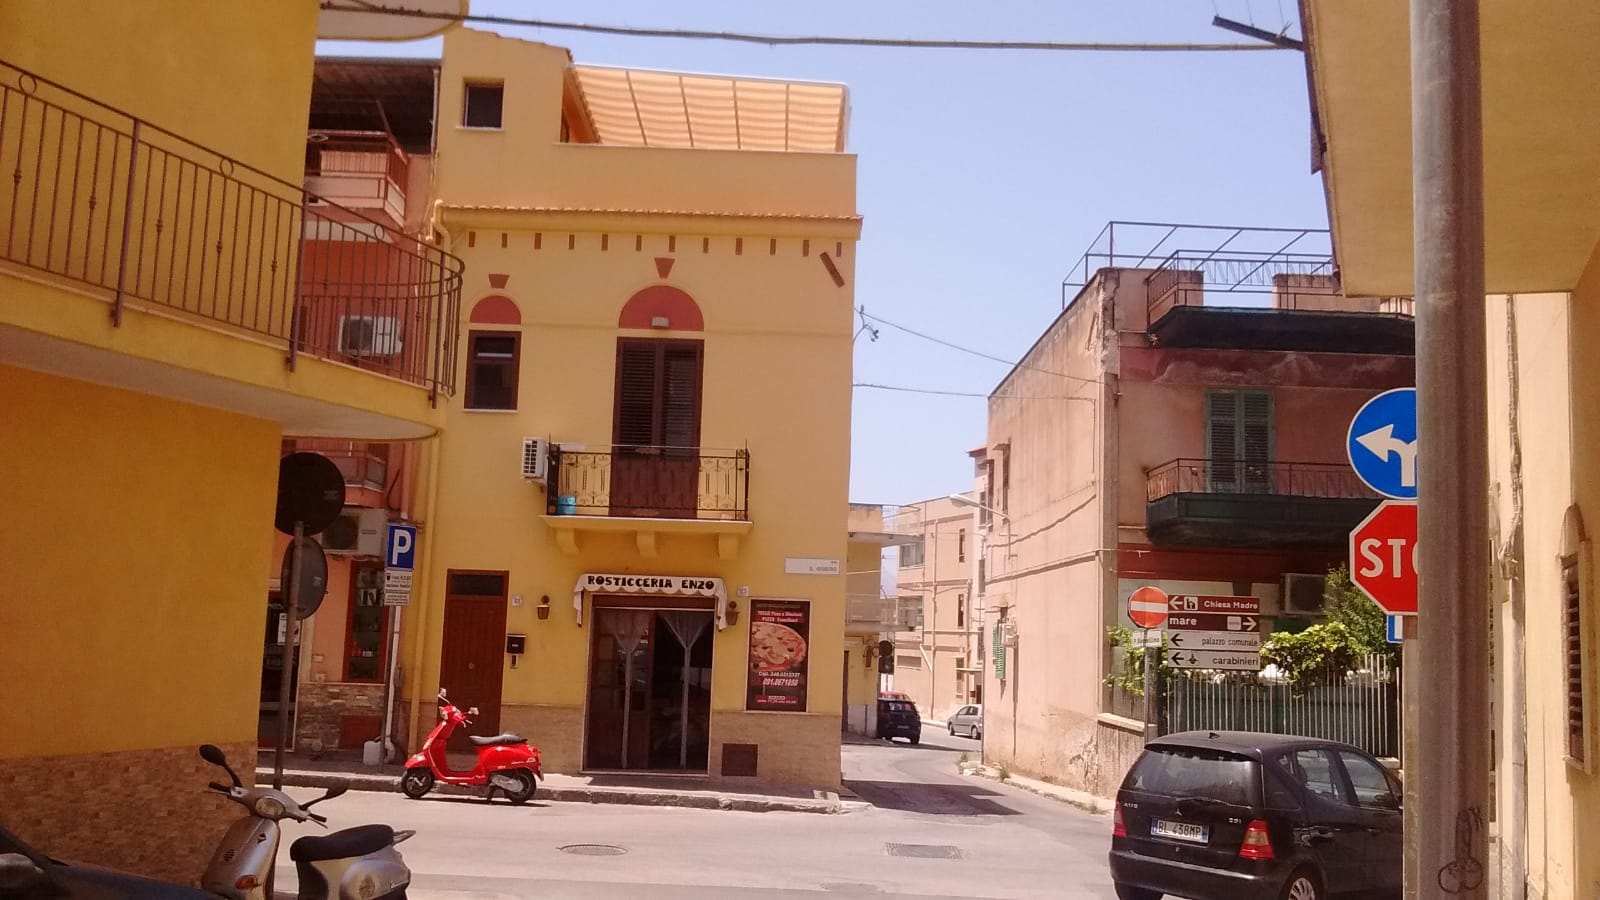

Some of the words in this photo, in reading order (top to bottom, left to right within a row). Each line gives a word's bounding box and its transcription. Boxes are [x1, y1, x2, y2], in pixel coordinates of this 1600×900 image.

[392, 529, 411, 565] P
[1360, 538, 1418, 578] ST
[587, 575, 673, 588] ROSTICCERIA
[681, 579, 715, 590] ENZO
[1233, 601, 1258, 609] Madre
[1169, 617, 1197, 626] mare
[1202, 637, 1226, 647] palazzo
[1228, 638, 1258, 647] comunale
[1212, 656, 1259, 666] carabinieri
[1158, 821, 1168, 834] BL
[1172, 824, 1201, 839] 438MP
